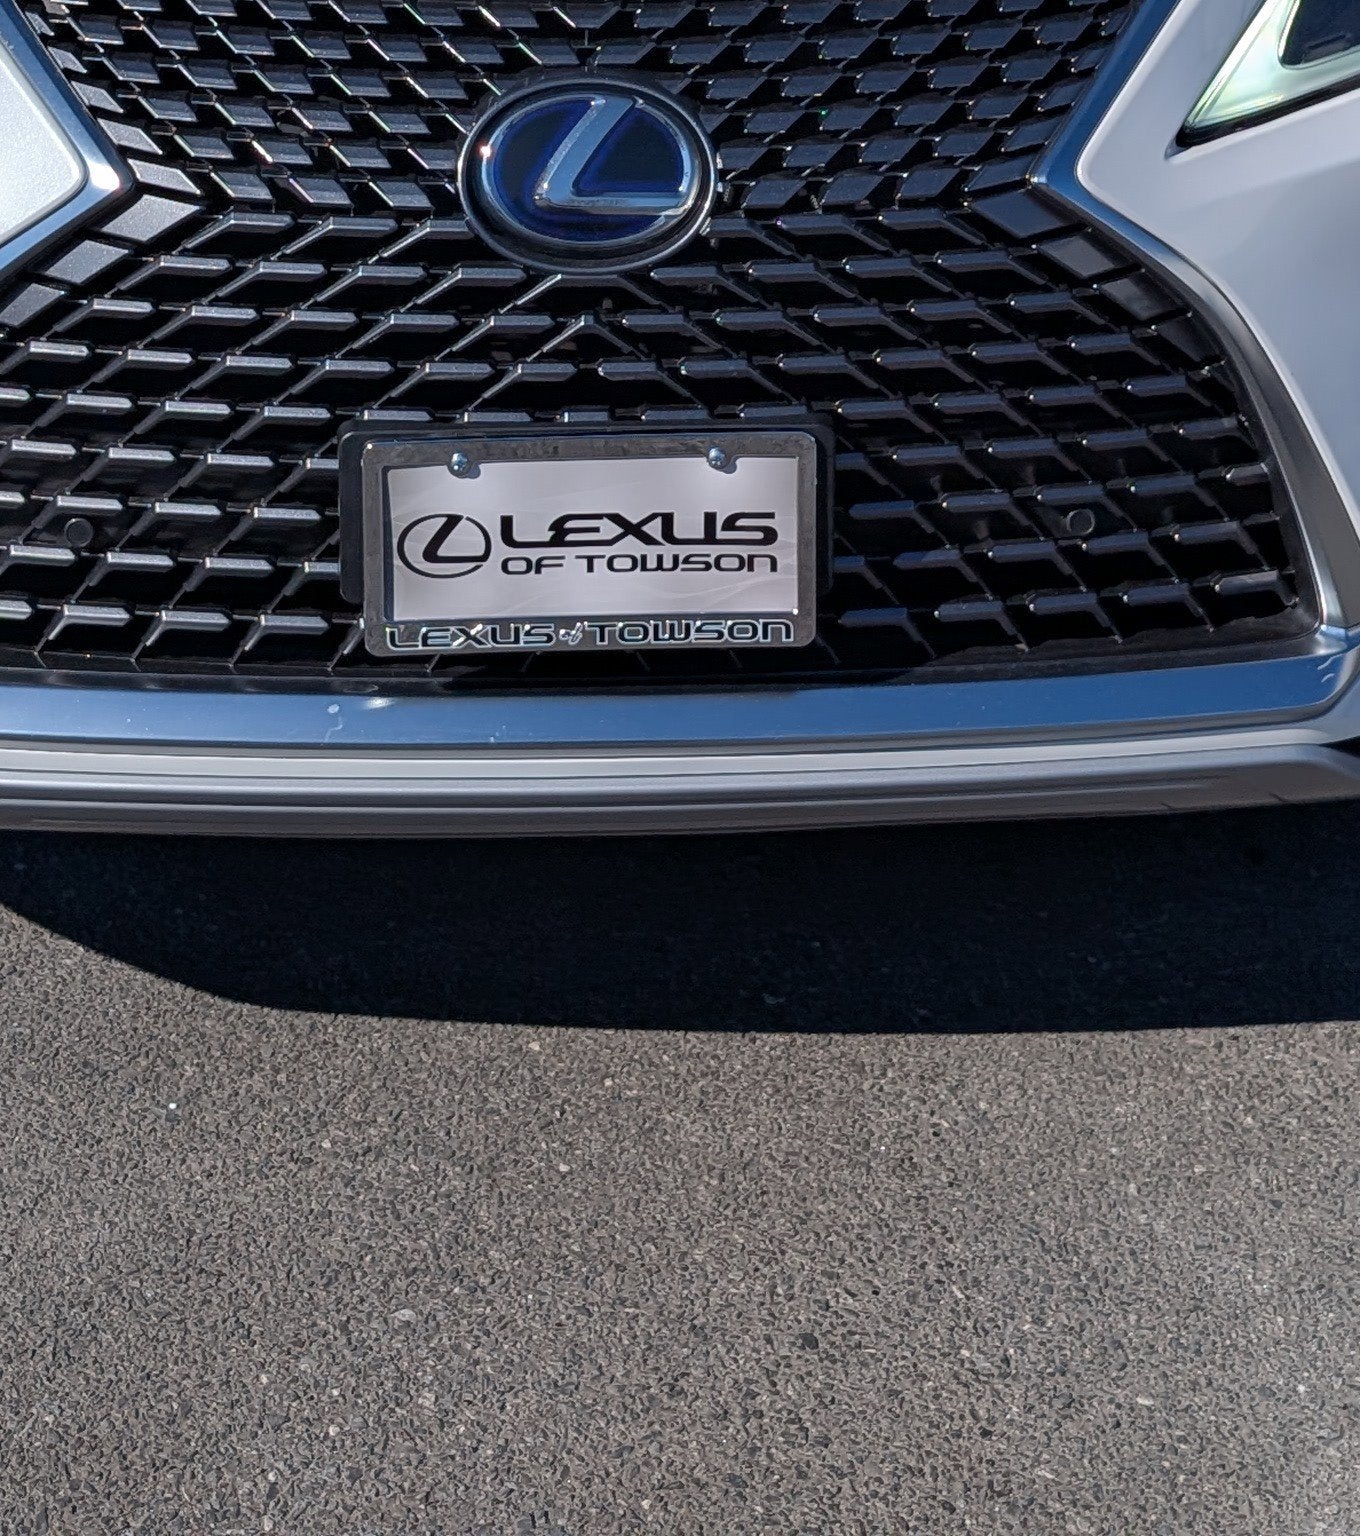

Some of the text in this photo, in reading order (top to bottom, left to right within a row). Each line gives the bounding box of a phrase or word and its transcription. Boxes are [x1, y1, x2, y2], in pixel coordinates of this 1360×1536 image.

[500, 511, 778, 548] LEXUS
[501, 553, 778, 575] OF TOWSON
[386, 623, 556, 651] LEXUS
[583, 619, 794, 645] TOWSON
